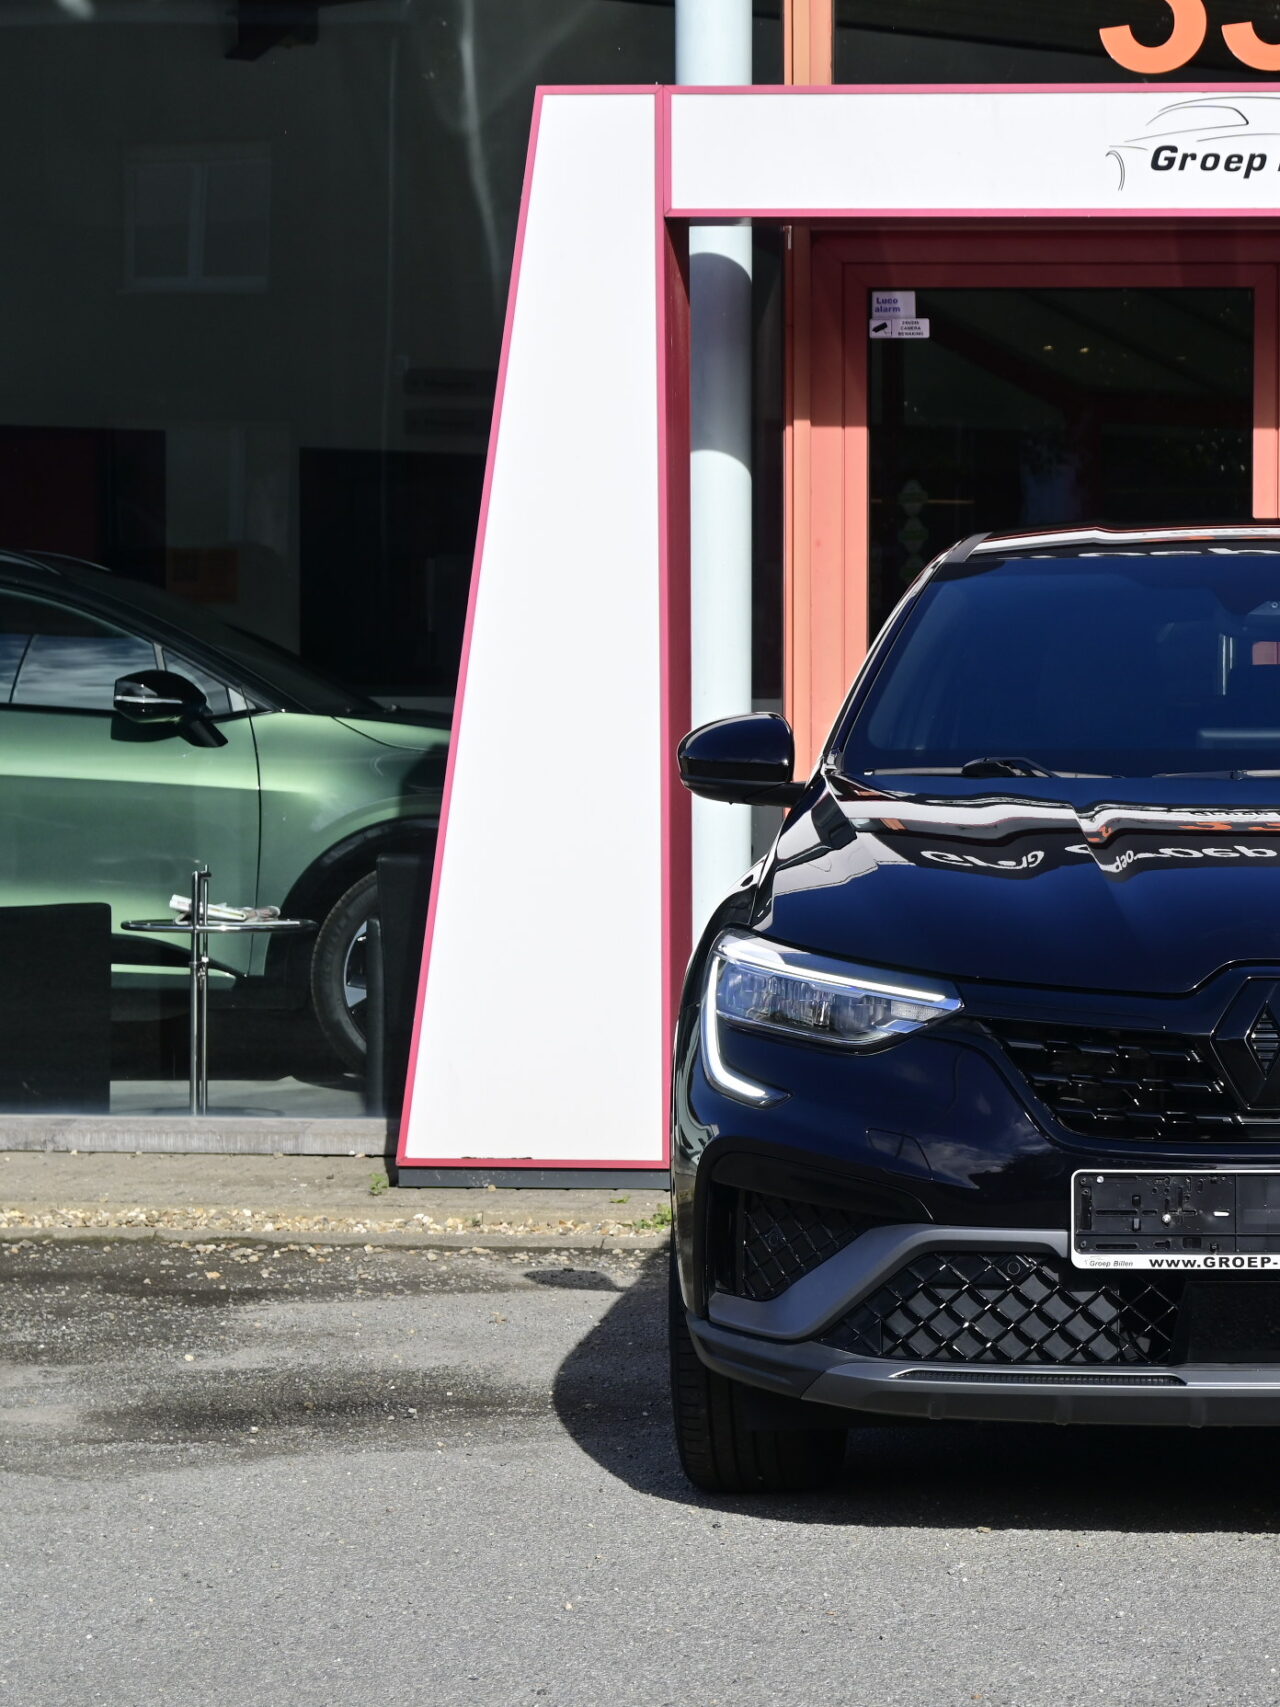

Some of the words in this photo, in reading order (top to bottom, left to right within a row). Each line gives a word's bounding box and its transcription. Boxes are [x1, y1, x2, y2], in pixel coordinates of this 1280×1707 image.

[1150, 145, 1267, 179] Groep
[874, 305, 901, 313] alarm
[1089, 1260, 1111, 1268] Groep
